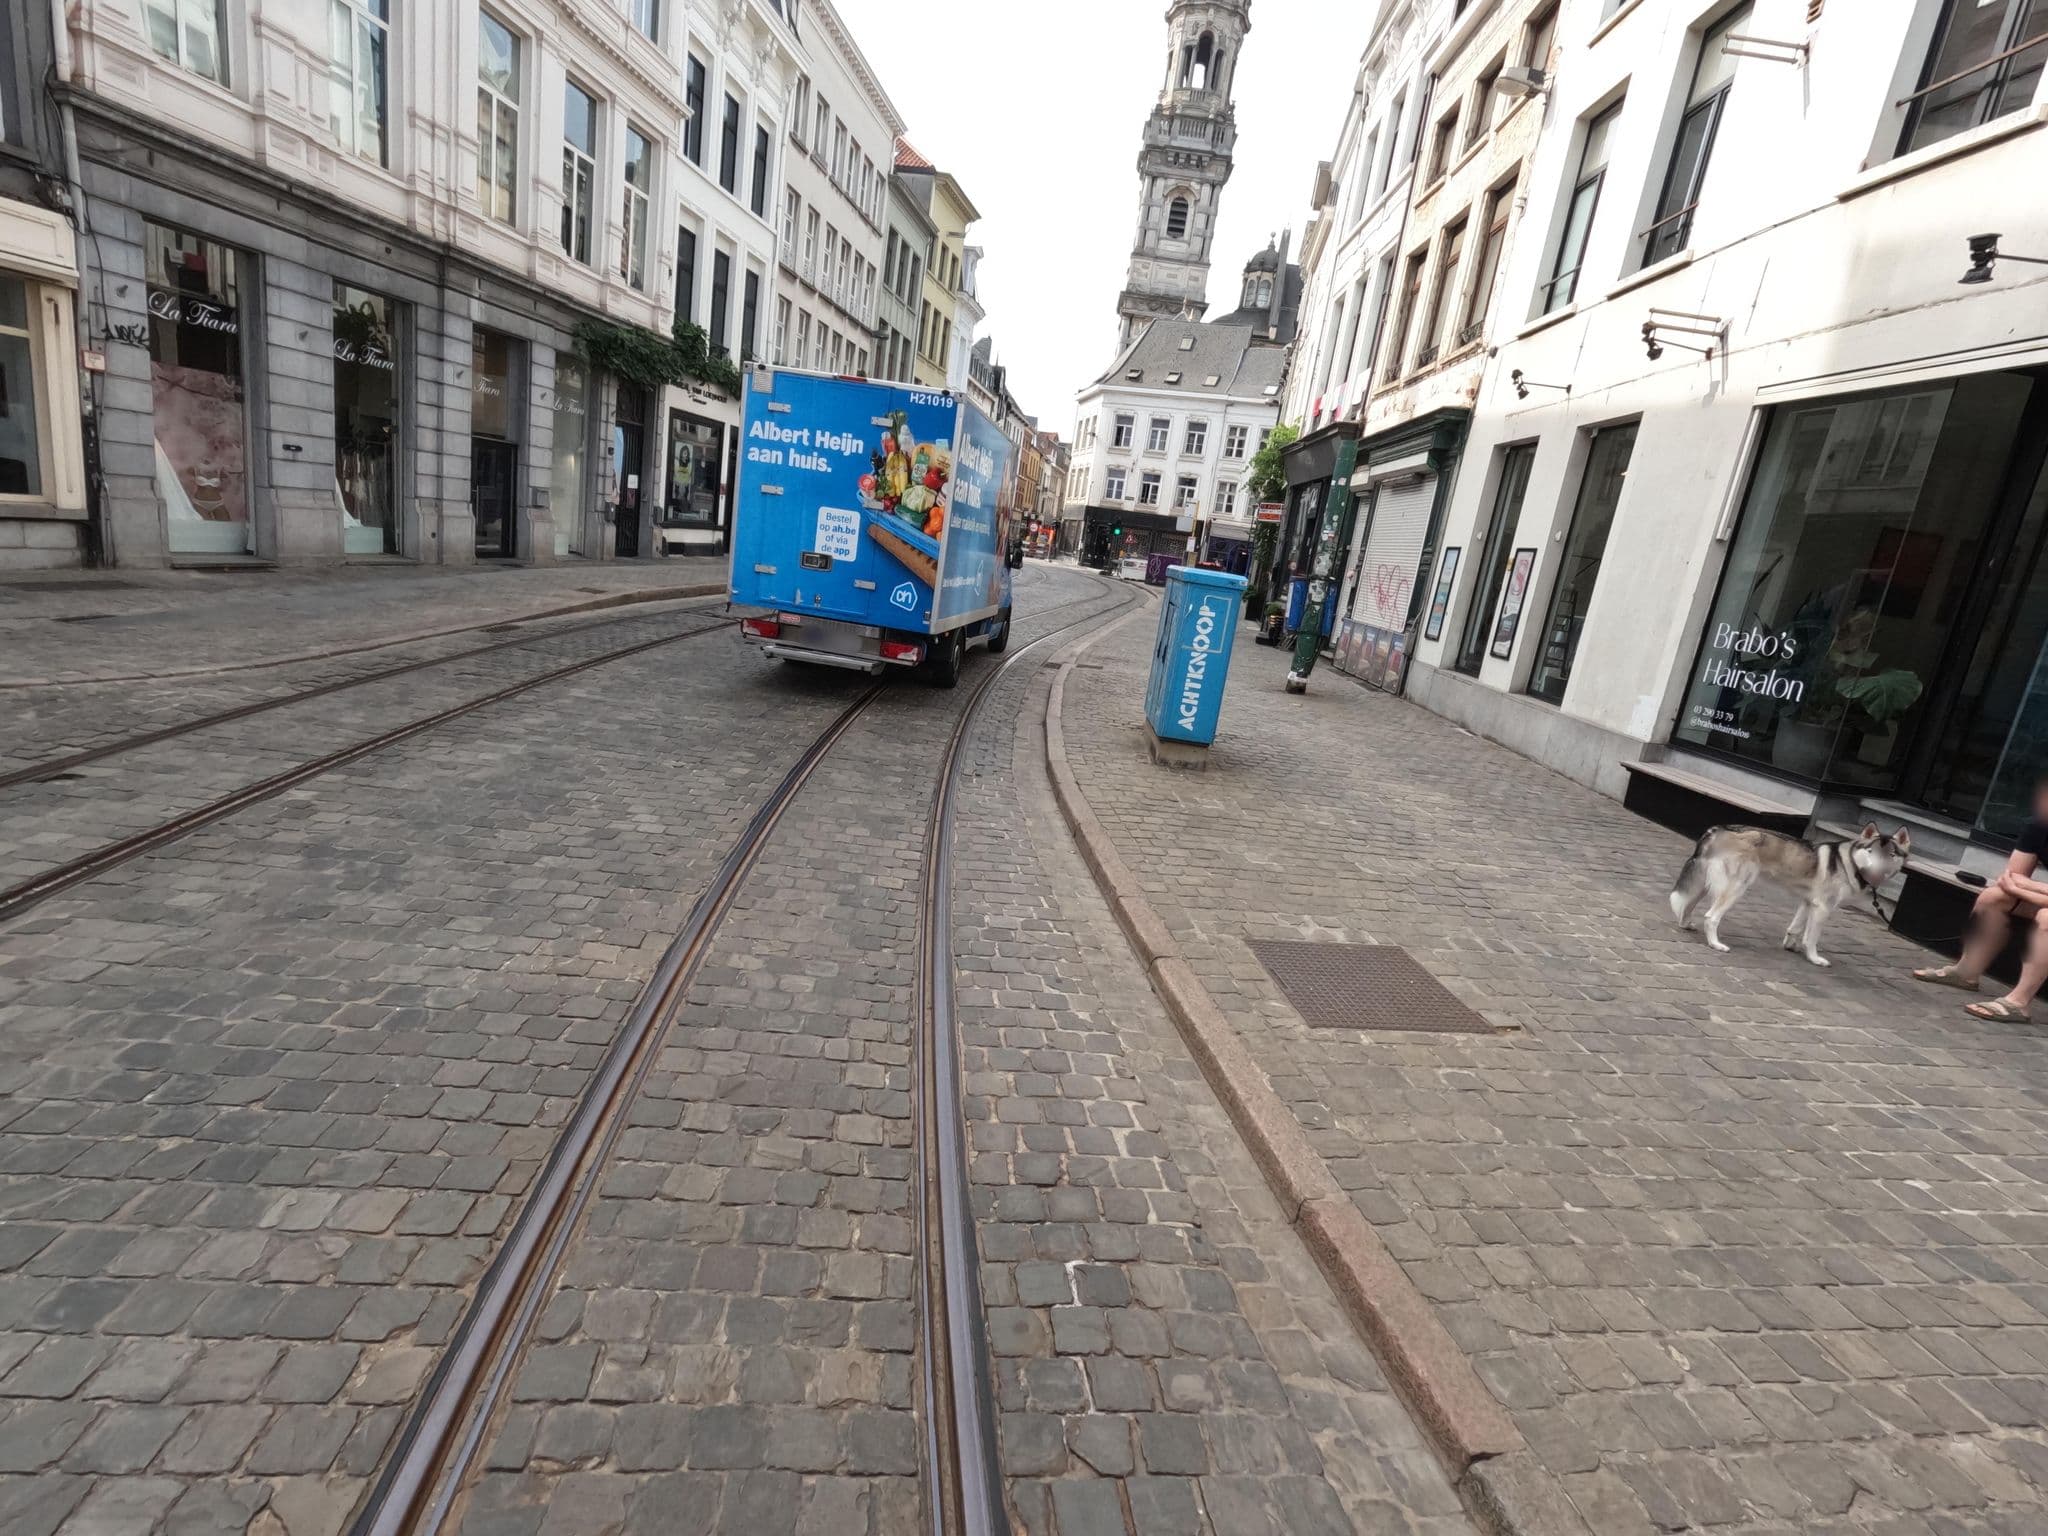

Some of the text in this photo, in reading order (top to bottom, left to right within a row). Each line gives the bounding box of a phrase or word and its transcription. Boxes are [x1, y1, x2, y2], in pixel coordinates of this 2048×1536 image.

[149, 291, 239, 334] La Tiara
[333, 337, 394, 370] La Tiara
[909, 391, 954, 409] H21019
[749, 420, 865, 457] Albert Heijn
[747, 446, 833, 473] aan huis.
[825, 512, 853, 525] Bestel
[819, 524, 856, 536] op ah.be
[825, 534, 848, 545] of via
[821, 544, 850, 557] de app
[1177, 605, 1217, 732] ACHTKNOOP
[1702, 658, 1804, 703] Hairsalon
[1693, 704, 1702, 714] 03
[1715, 710, 1724, 720] 33
[1725, 712, 1734, 722] 79
